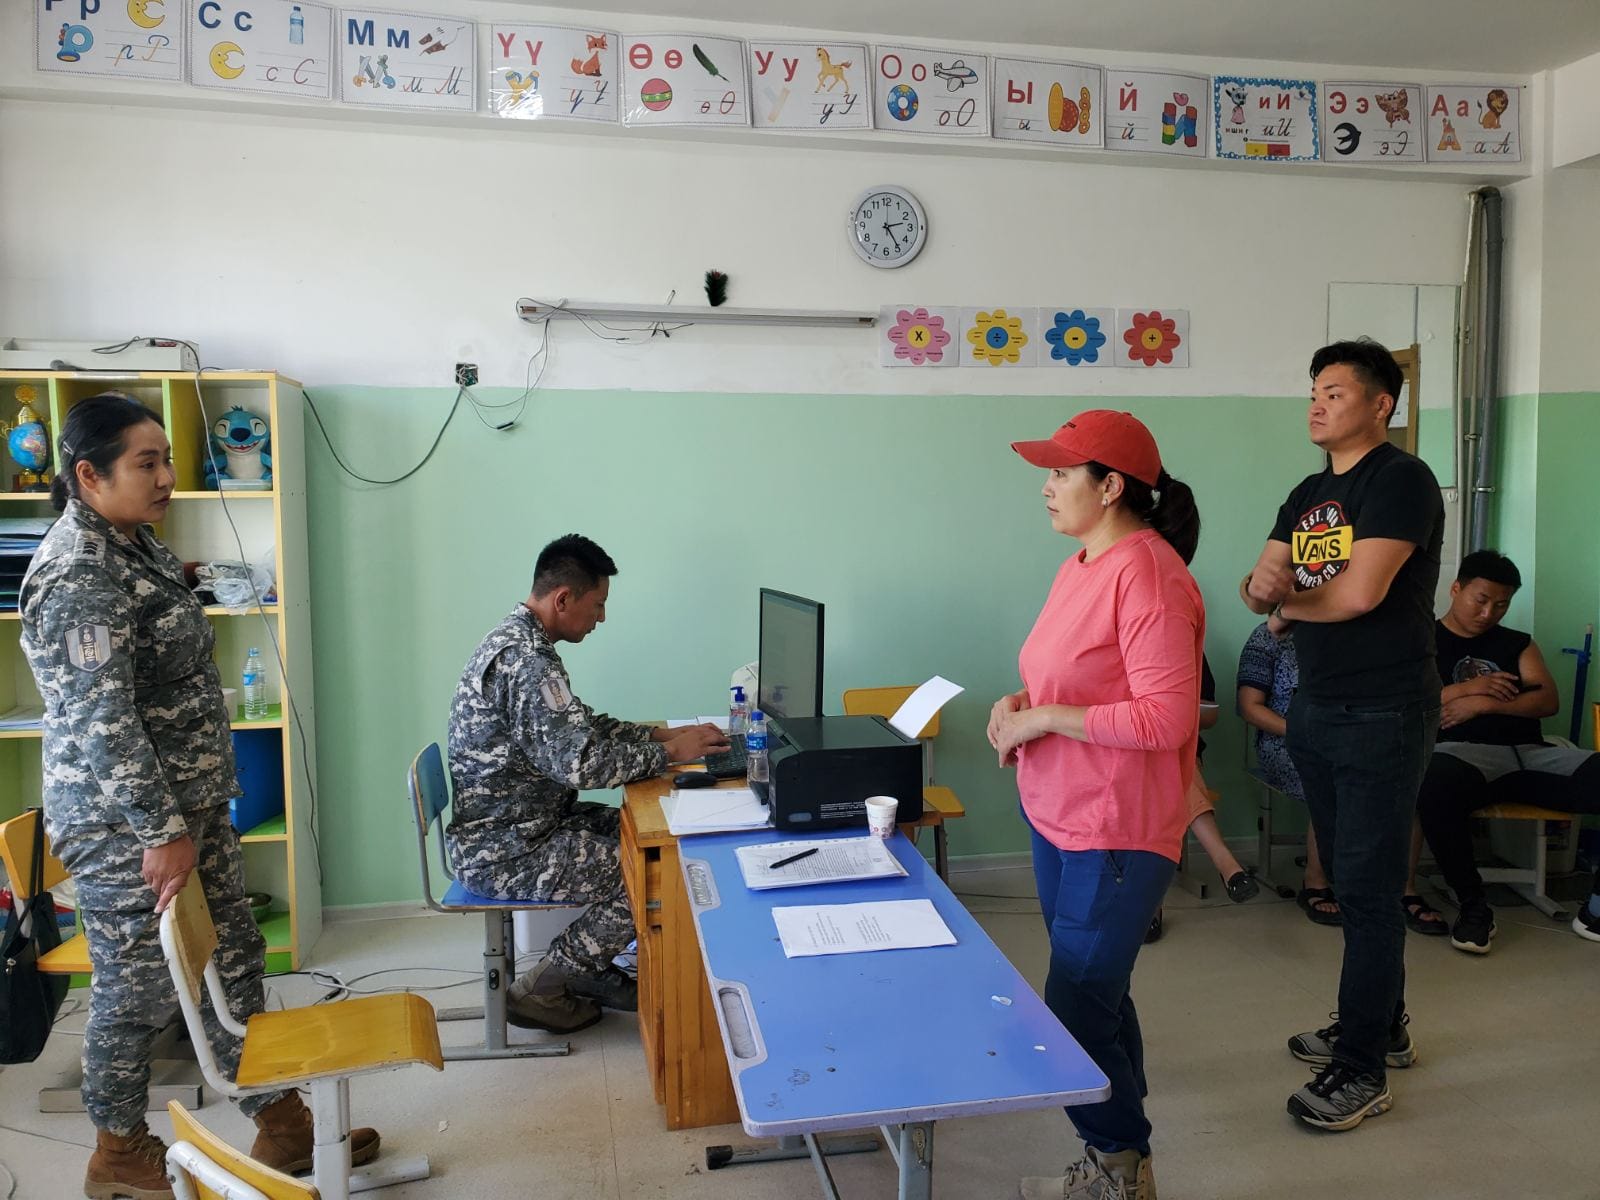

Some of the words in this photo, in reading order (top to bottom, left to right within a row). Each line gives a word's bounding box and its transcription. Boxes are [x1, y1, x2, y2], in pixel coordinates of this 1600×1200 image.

[1119, 82, 1137, 111] Й
[871, 201, 879, 209] 11
[882, 197, 892, 206] 12
[896, 201, 900, 210] 1
[863, 210, 872, 219] 10
[902, 212, 909, 220] 2
[860, 221, 866, 230] 9
[907, 223, 913, 232] 3
[864, 233, 870, 242] 8
[902, 235, 909, 243] 4
[872, 243, 878, 252] 7
[883, 247, 890, 256] 6
[894, 244, 901, 253] 5
[1297, 530, 1341, 561] VANS
